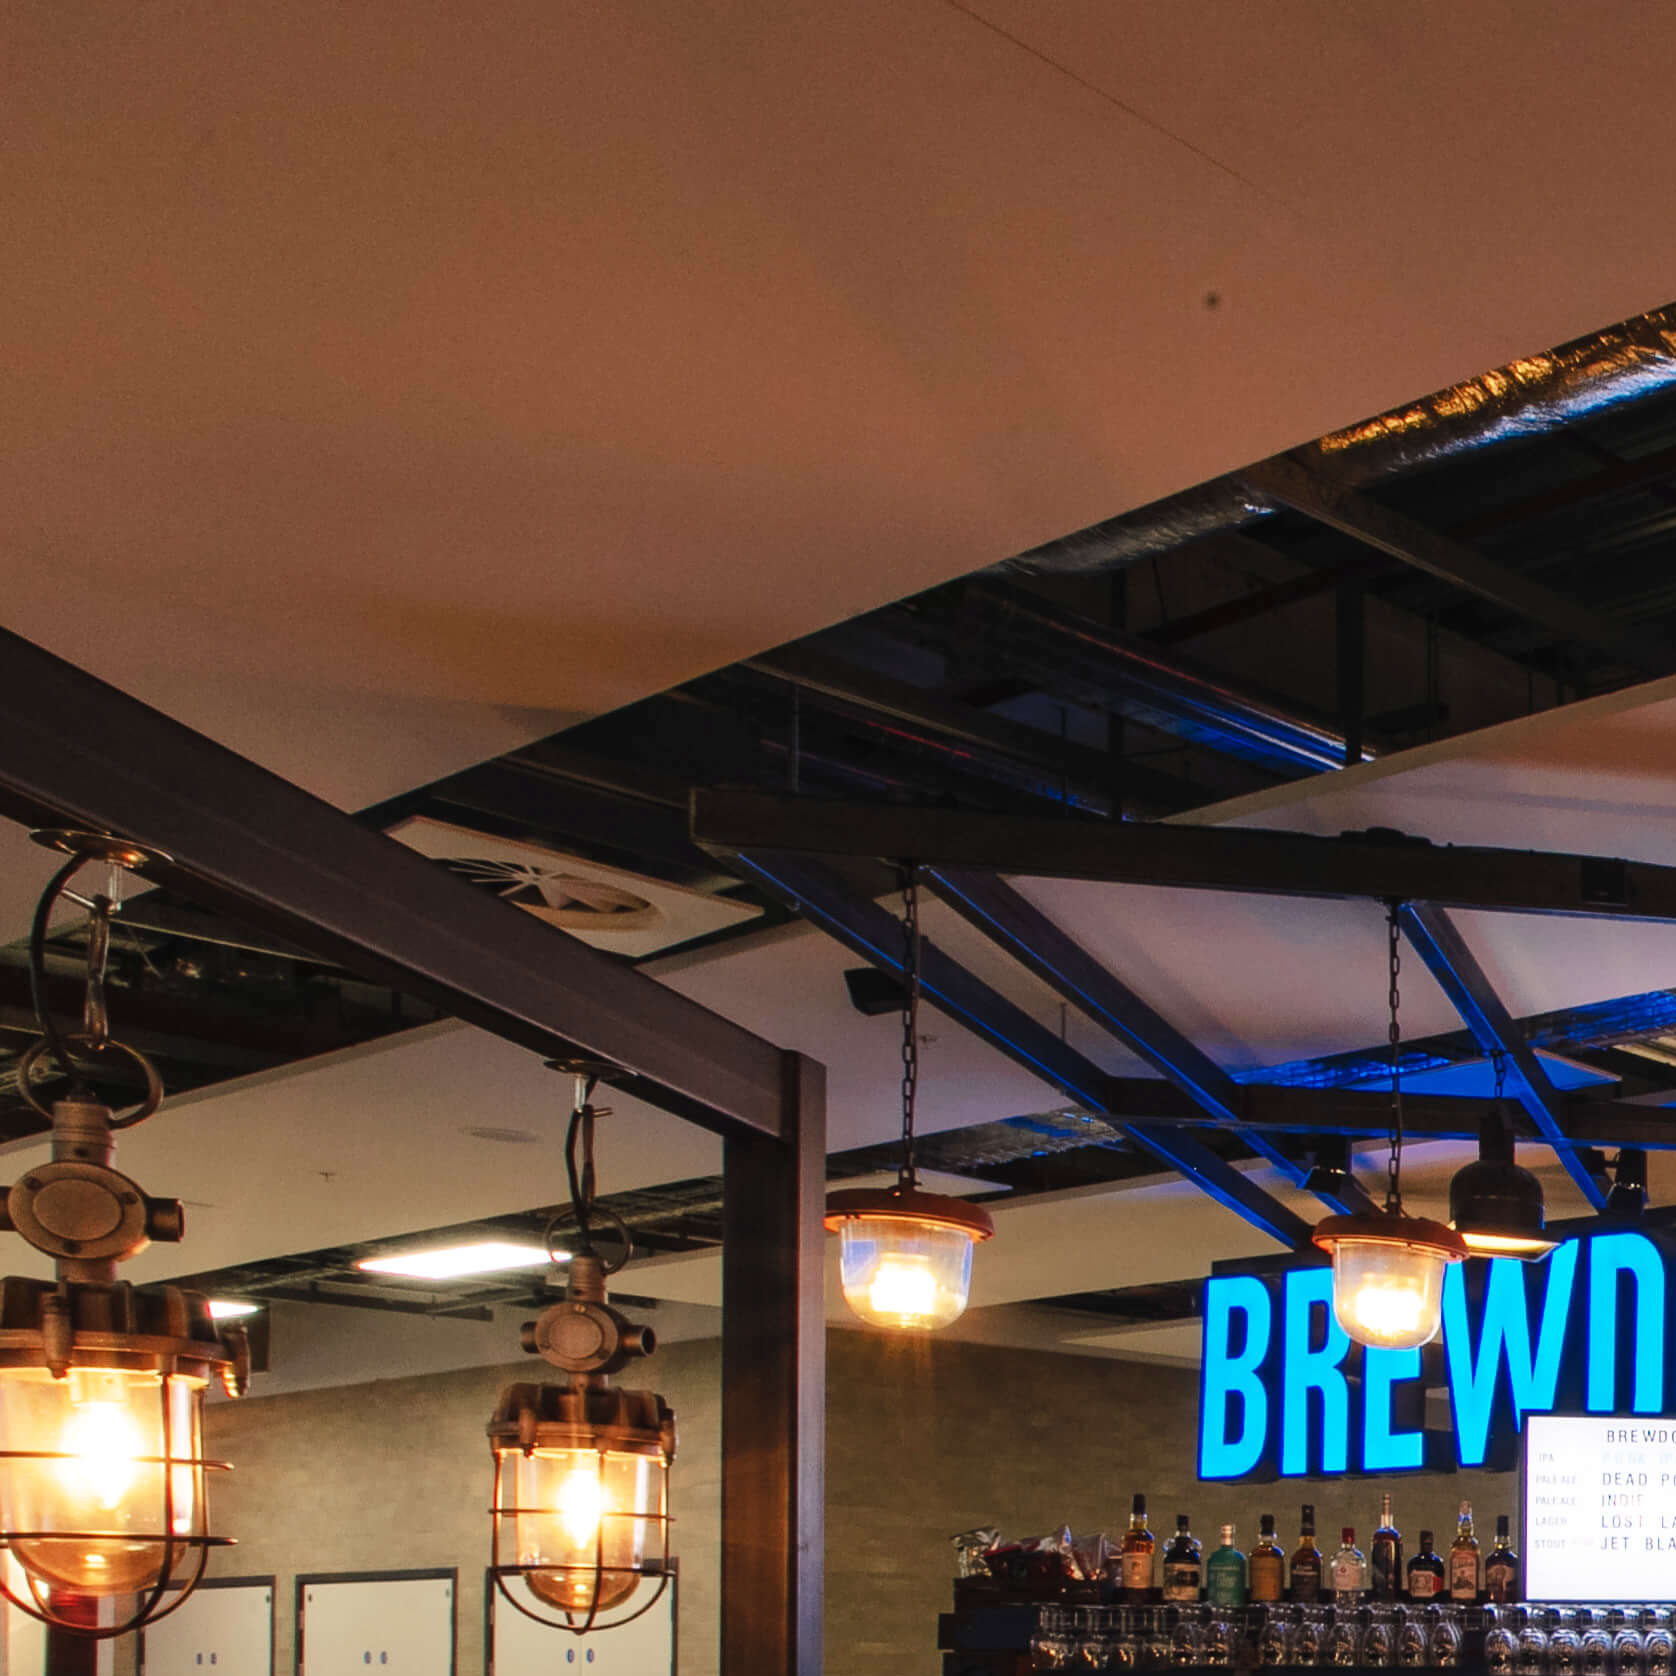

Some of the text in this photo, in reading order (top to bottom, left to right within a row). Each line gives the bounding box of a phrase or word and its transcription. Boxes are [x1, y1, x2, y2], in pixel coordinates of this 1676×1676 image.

[1602, 1471, 1648, 1487] DEAD
[1601, 1514, 1646, 1529] LOST
[1600, 1536, 1630, 1551] JET
